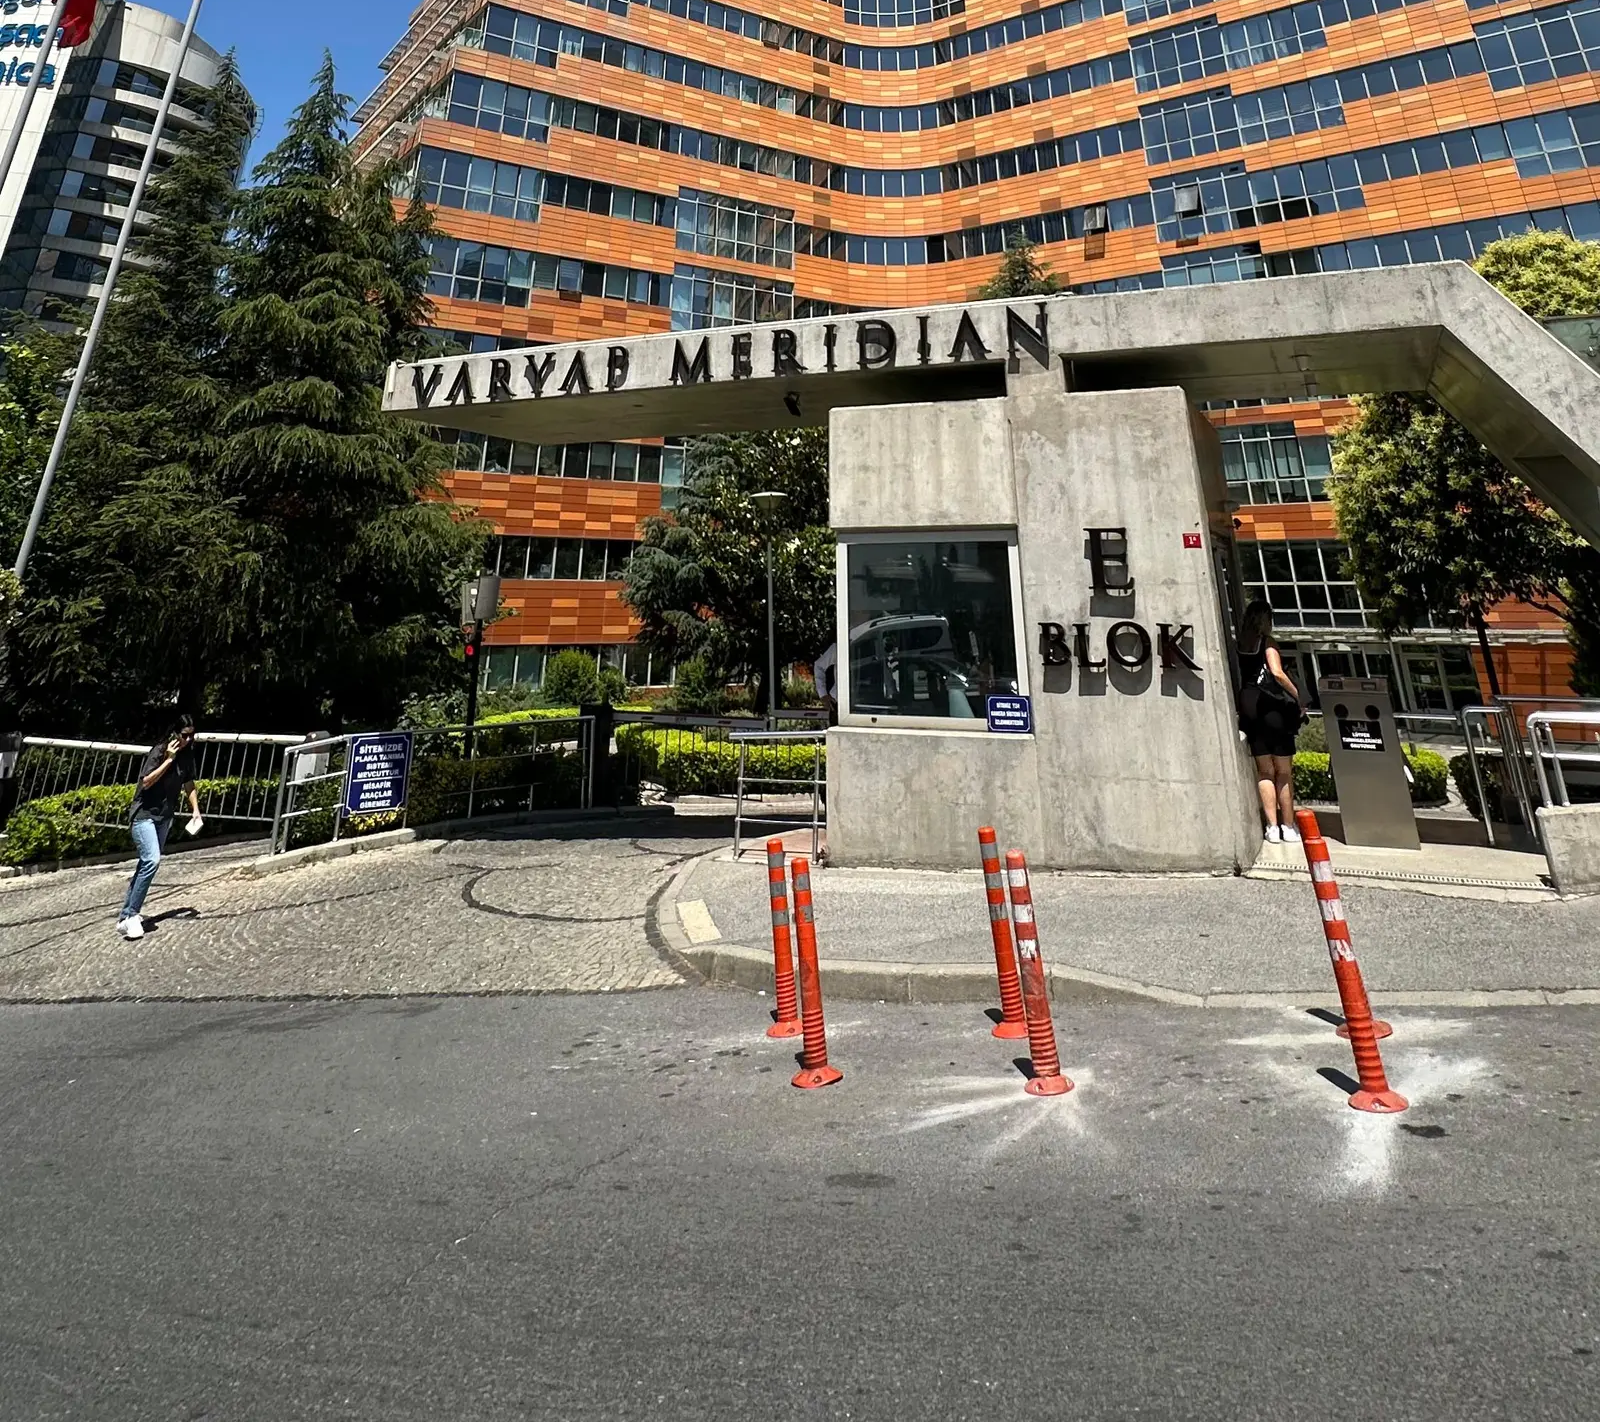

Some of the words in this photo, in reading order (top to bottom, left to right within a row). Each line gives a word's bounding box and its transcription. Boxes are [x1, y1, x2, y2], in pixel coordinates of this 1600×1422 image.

[412, 345, 629, 409] VARYAP
[669, 301, 1050, 386] MERIDIAN
[1083, 527, 1135, 594] E
[1038, 621, 1204, 672] BLOK
[359, 742, 403, 755] SİTEMİZDE
[355, 754, 378, 763] PLAKA
[357, 769, 400, 778] MEVCUTTUR
[363, 780, 391, 790] MİSAFİR
[360, 790, 393, 800] ARAÇLAR
